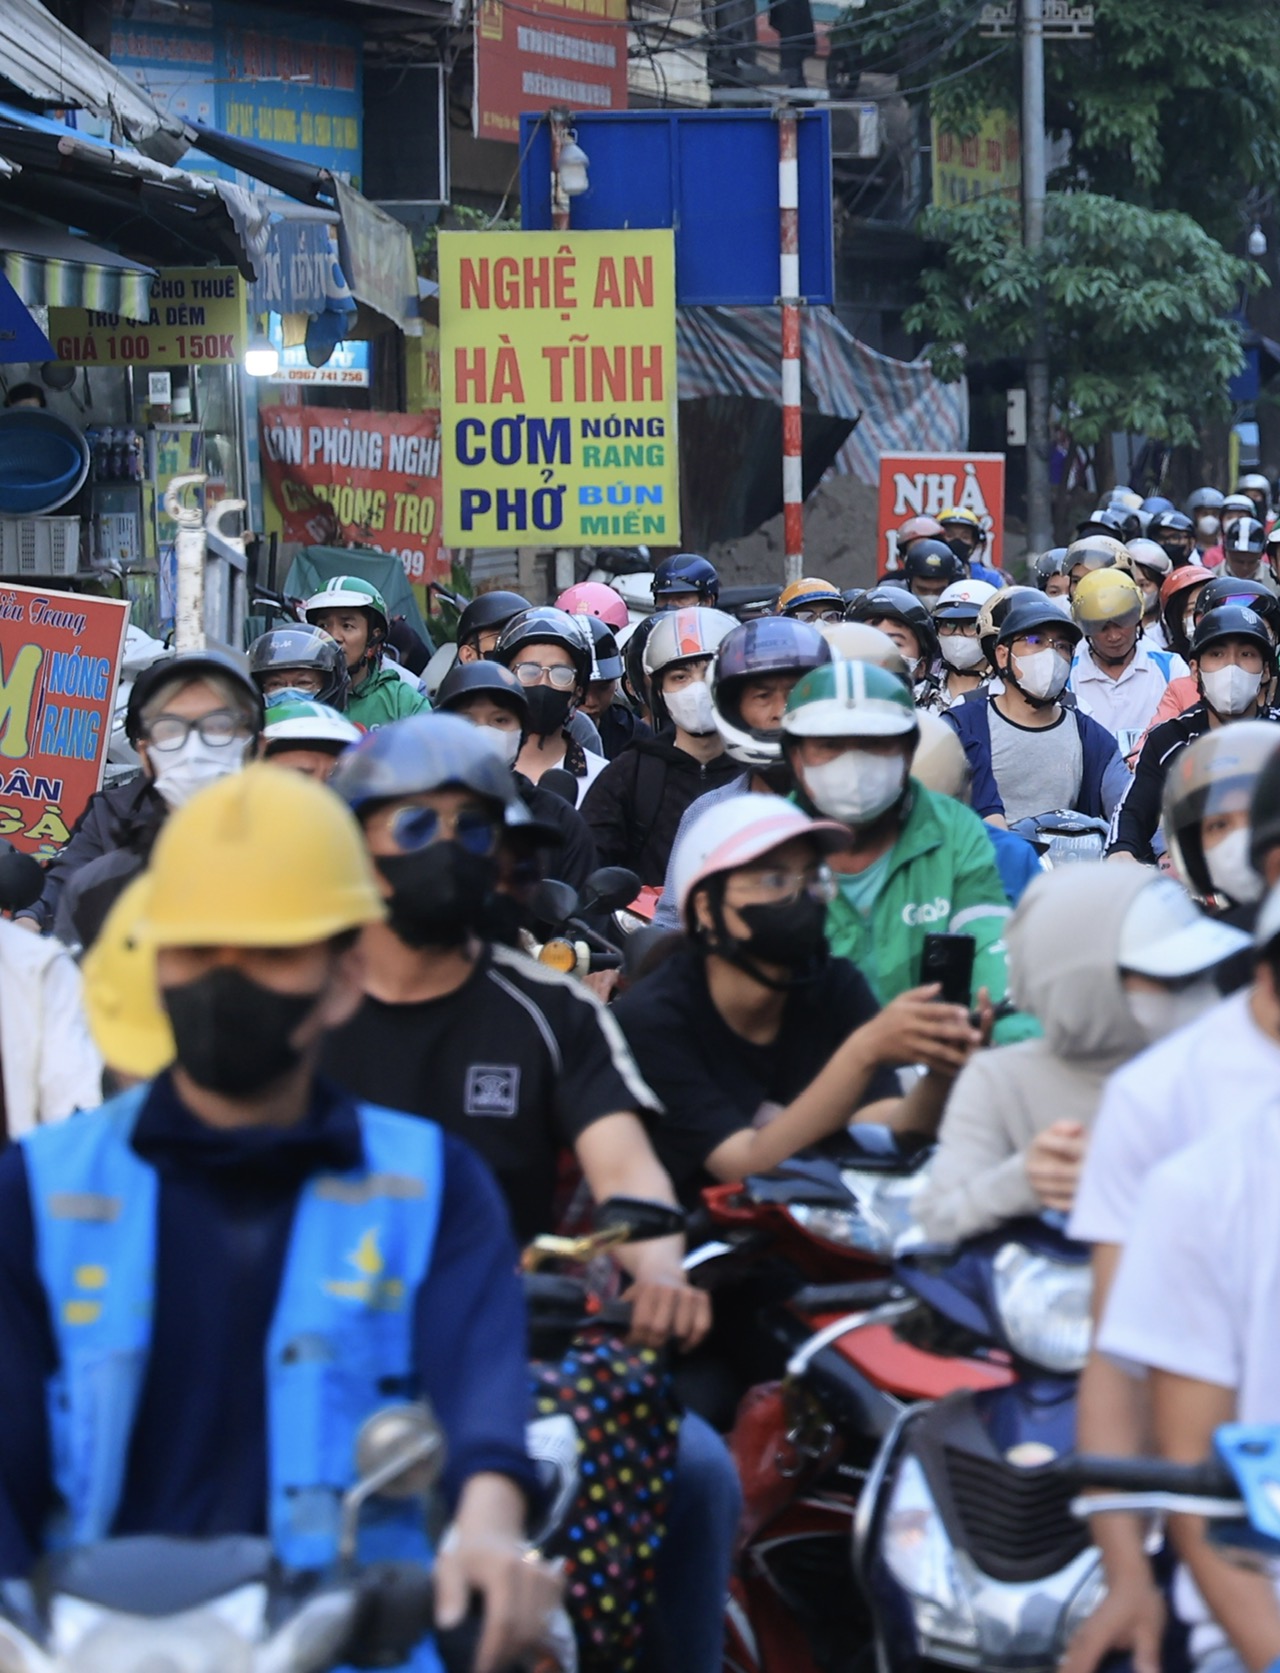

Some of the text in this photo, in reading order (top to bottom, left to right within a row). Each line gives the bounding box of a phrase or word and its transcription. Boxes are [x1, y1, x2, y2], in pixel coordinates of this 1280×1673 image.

[151, 276, 235, 299] CHO THUÊ
[459, 245, 654, 321] NGHỆ AN
[57, 332, 98, 361] GIÁ
[107, 335, 149, 360] 100
[176, 334, 235, 359] 150K
[454, 334, 525, 404] HÀ
[542, 334, 664, 403] TĨNH
[308, 417, 384, 471] PHÒNG
[455, 414, 572, 466] CƠM
[581, 413, 665, 438] NÓNG
[582, 444, 665, 467] RANG
[460, 469, 566, 531] PHỞ
[578, 480, 663, 505] BÚN
[893, 462, 989, 516] NHÀ
[394, 492, 435, 545] TRỌ
[580, 507, 665, 536] MIẾN
[29, 597, 87, 637] Trang
[48, 645, 110, 700] NÓNG
[39, 704, 102, 762] RANG
[0, 767, 64, 803] ÂN
